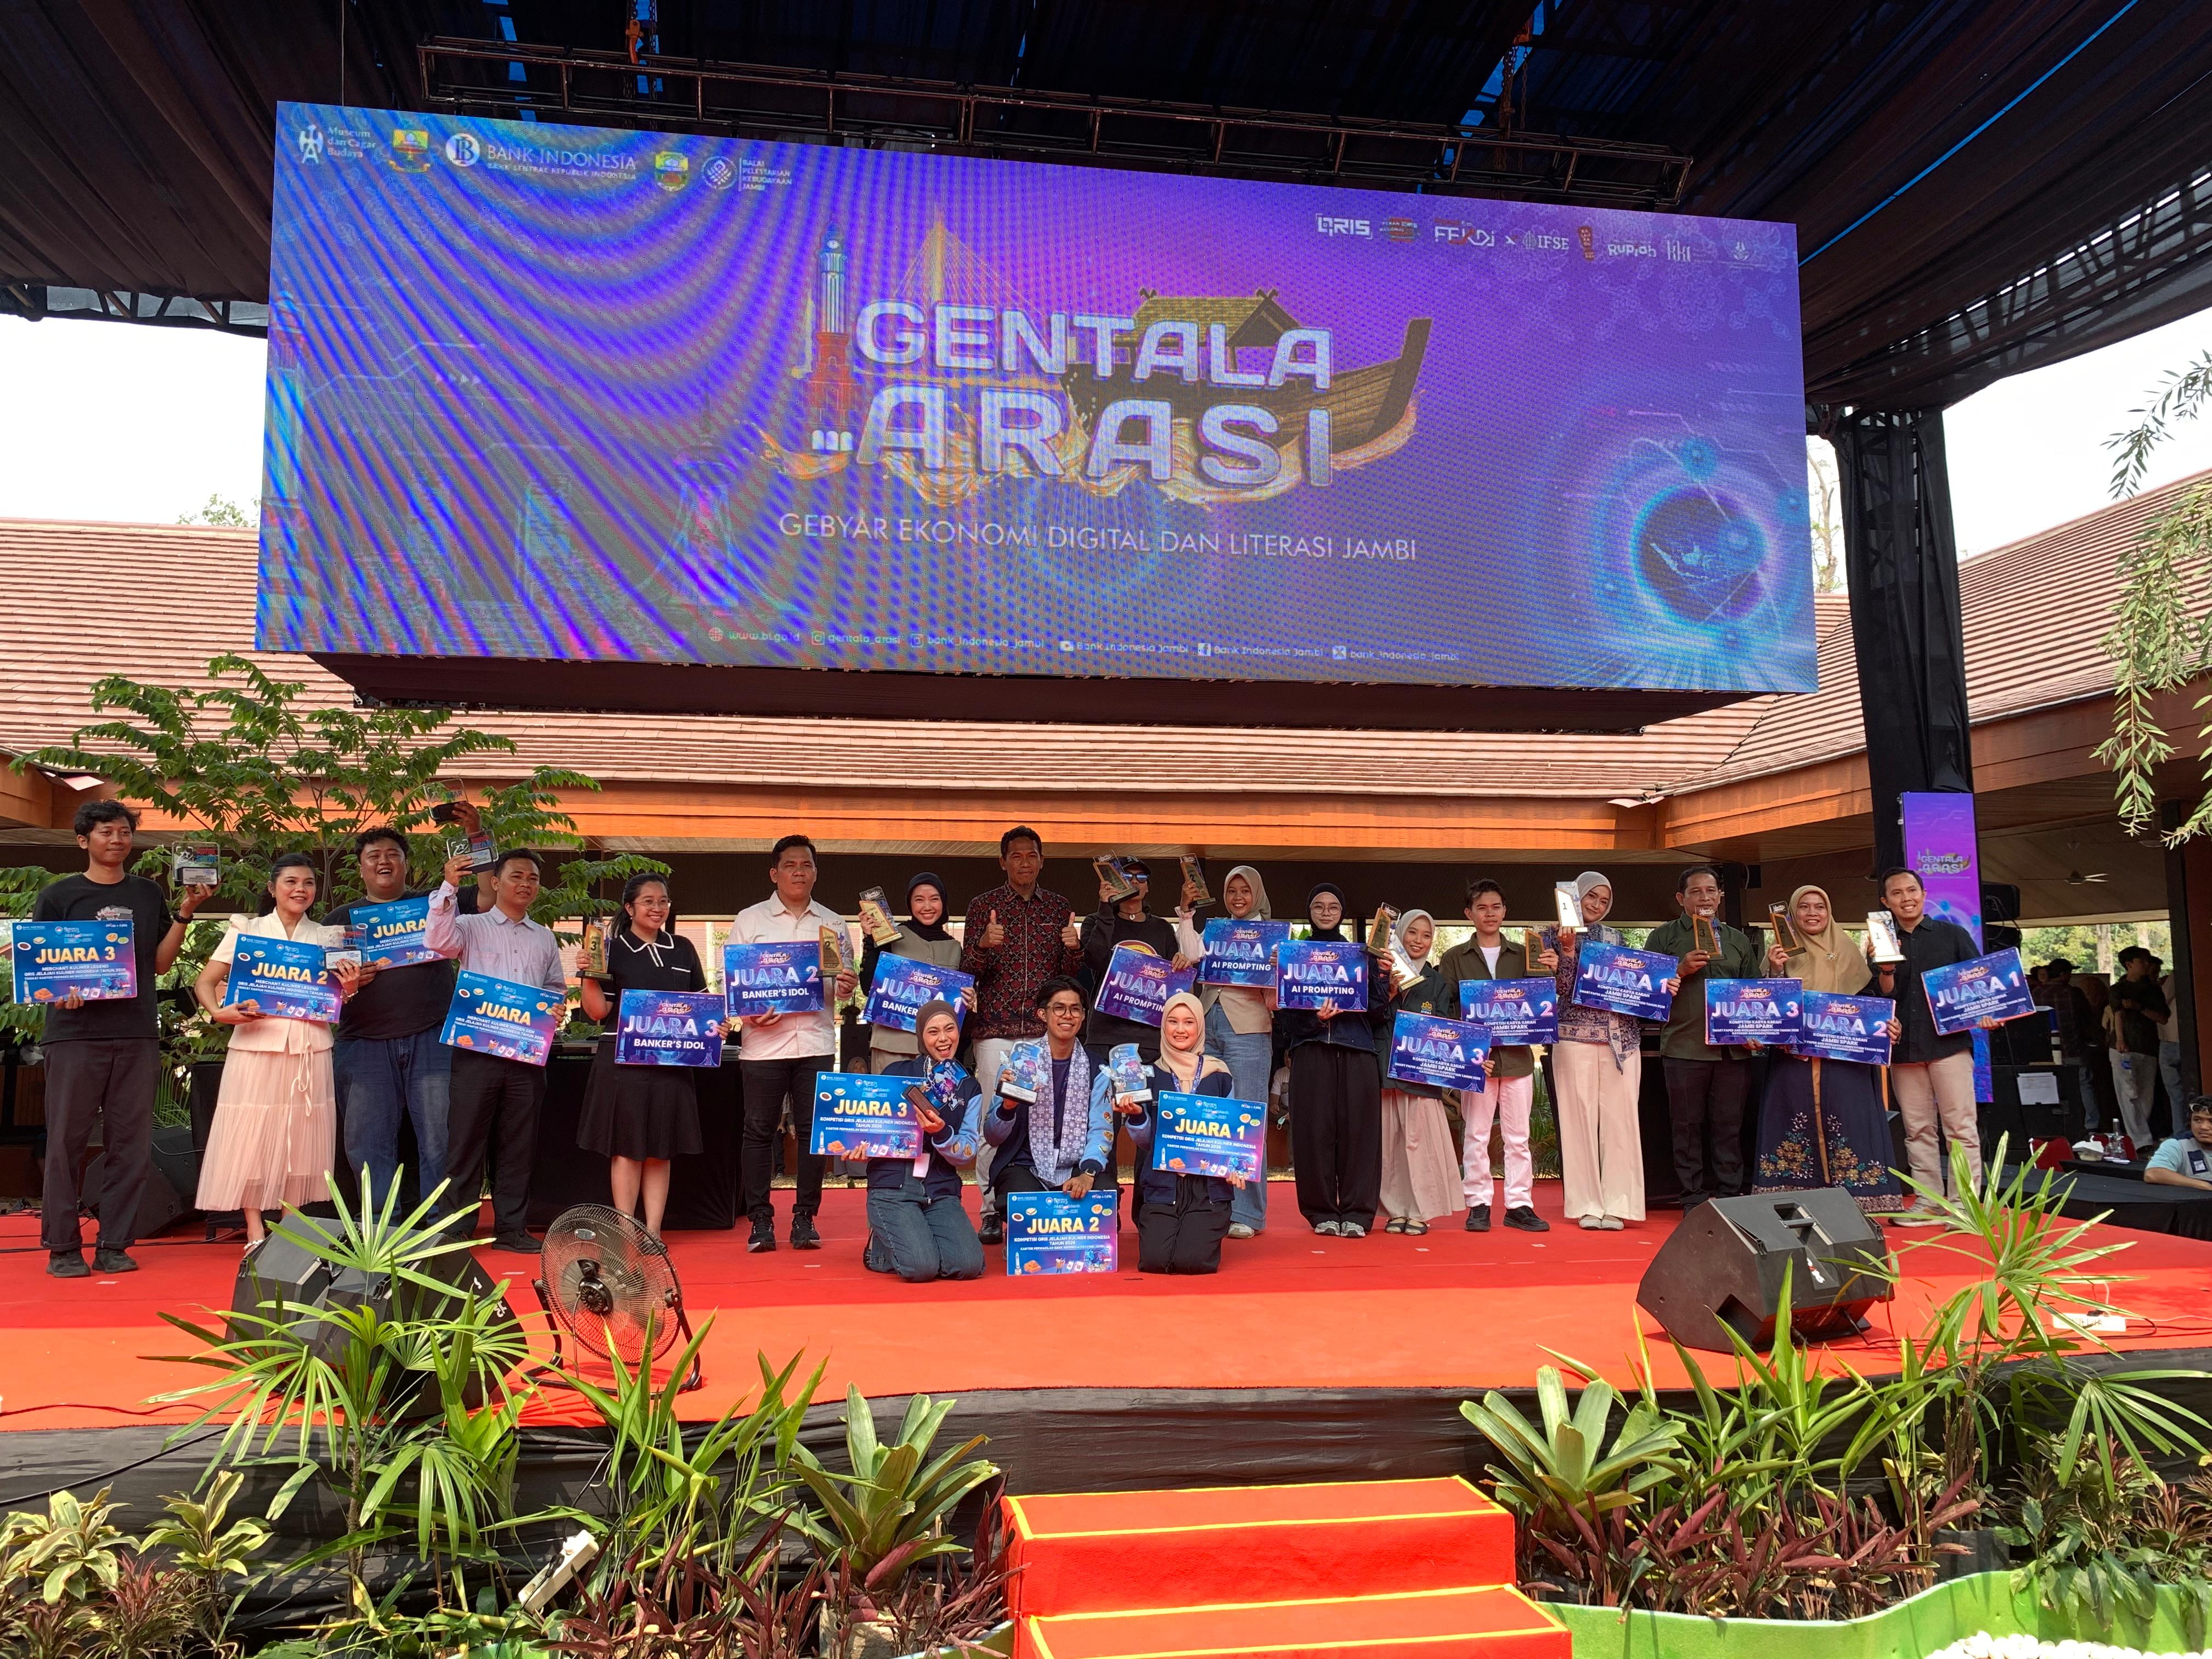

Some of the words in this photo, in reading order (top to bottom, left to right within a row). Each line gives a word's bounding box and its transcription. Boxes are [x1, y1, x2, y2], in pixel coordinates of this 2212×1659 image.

[487, 144, 534, 162] BANK
[540, 148, 637, 171] INDONESIA
[1318, 216, 1371, 238] QRIS
[1537, 235, 1570, 250] IFSE
[853, 298, 1331, 390] GENTALA
[856, 382, 1332, 487] ARASI
[779, 512, 889, 540] GEBYAR
[899, 518, 1037, 548] EKONOMI
[1048, 526, 1150, 552] DIGITAL
[1161, 531, 1219, 554] DAN
[1231, 533, 1332, 560] LITERASI
[1342, 538, 1416, 560] JAMBI
[1922, 864, 1964, 873] ARASI
[1562, 902, 1568, 910] 1
[373, 918, 427, 939] JUARA
[1699, 928, 1705, 937] 3
[35, 947, 100, 964] JUARA
[104, 946, 116, 961] 3
[590, 941, 597, 951] 3
[1205, 940, 1264, 958] JUARA
[1531, 943, 1536, 952] 2
[251, 962, 312, 983] JUARA
[317, 970, 328, 985] 2
[1222, 962, 1272, 971] PROMPTING
[1283, 963, 1349, 982] JUARA
[1354, 966, 1362, 983] 1
[730, 967, 800, 986] JUARA
[806, 966, 819, 983] 2
[1109, 970, 1167, 1000] JUARA
[1582, 963, 1652, 992] JUARA
[1660, 978, 1668, 994] 1
[742, 989, 787, 999] BANKER'S
[788, 988, 809, 997] IDOL
[1302, 986, 1355, 995] PROMPTING
[1622, 992, 1641, 1001] SPARK
[1936, 976, 2006, 1007] JUARA
[2008, 970, 2020, 988] 1
[882, 1000, 918, 1015] BANKER
[953, 996, 962, 1014] 1
[1113, 992, 1122, 1001] AI
[1124, 995, 1165, 1012] PROMPTIN
[1466, 1002, 1534, 1019] JUARA
[1539, 1001, 1554, 1017] 2
[1712, 1002, 1781, 1018] JUARA
[1786, 1001, 1799, 1018] 3
[1981, 999, 2000, 1009] SPARK
[467, 1015, 492, 1024] MERCHANT
[476, 1001, 531, 1026] JUARA
[499, 1026, 521, 1036] INDONESIA
[624, 1015, 698, 1036] JUARA
[704, 1019, 718, 1037] 3
[1872, 1020, 1887, 1037] 2
[634, 1038, 681, 1049] BANKER'S
[683, 1040, 705, 1050] IDOL
[1396, 1035, 1465, 1063] JUARA
[1470, 1048, 1485, 1064] 3
[1412, 1056, 1435, 1064] KOMPETISI
[833, 1099, 892, 1116] JUARA
[897, 1102, 907, 1118] 3
[1175, 1118, 1231, 1138] JUARA
[1237, 1125, 1245, 1141] 1
[1026, 1217, 1085, 1234] JUARA
[1089, 1216, 1100, 1232] 2
